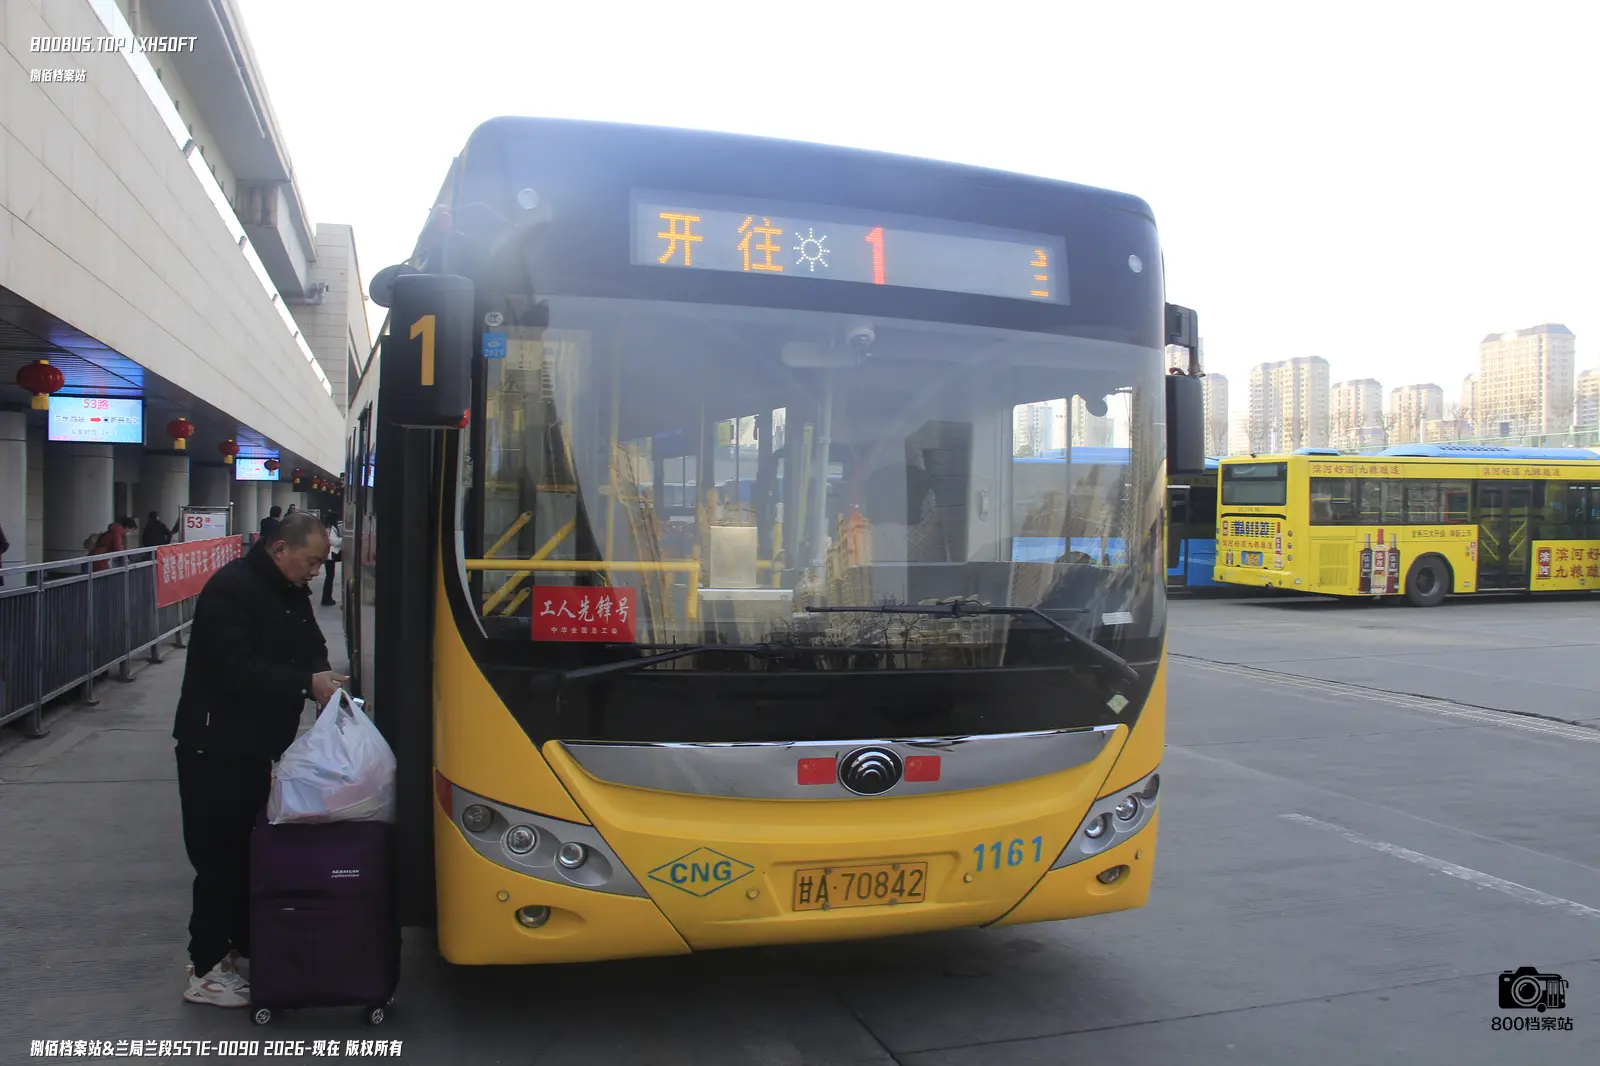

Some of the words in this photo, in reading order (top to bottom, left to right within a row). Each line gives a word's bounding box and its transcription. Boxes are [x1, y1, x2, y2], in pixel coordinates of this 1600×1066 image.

[865, 226, 885, 286] 1
[409, 314, 436, 386] 1
[187, 516, 203, 529] 53
[539, 594, 631, 624] 工人先锋号
[550, 625, 619, 635] 中华全国总工会
[972, 835, 1044, 872] 1161
[669, 859, 733, 884] CNG
